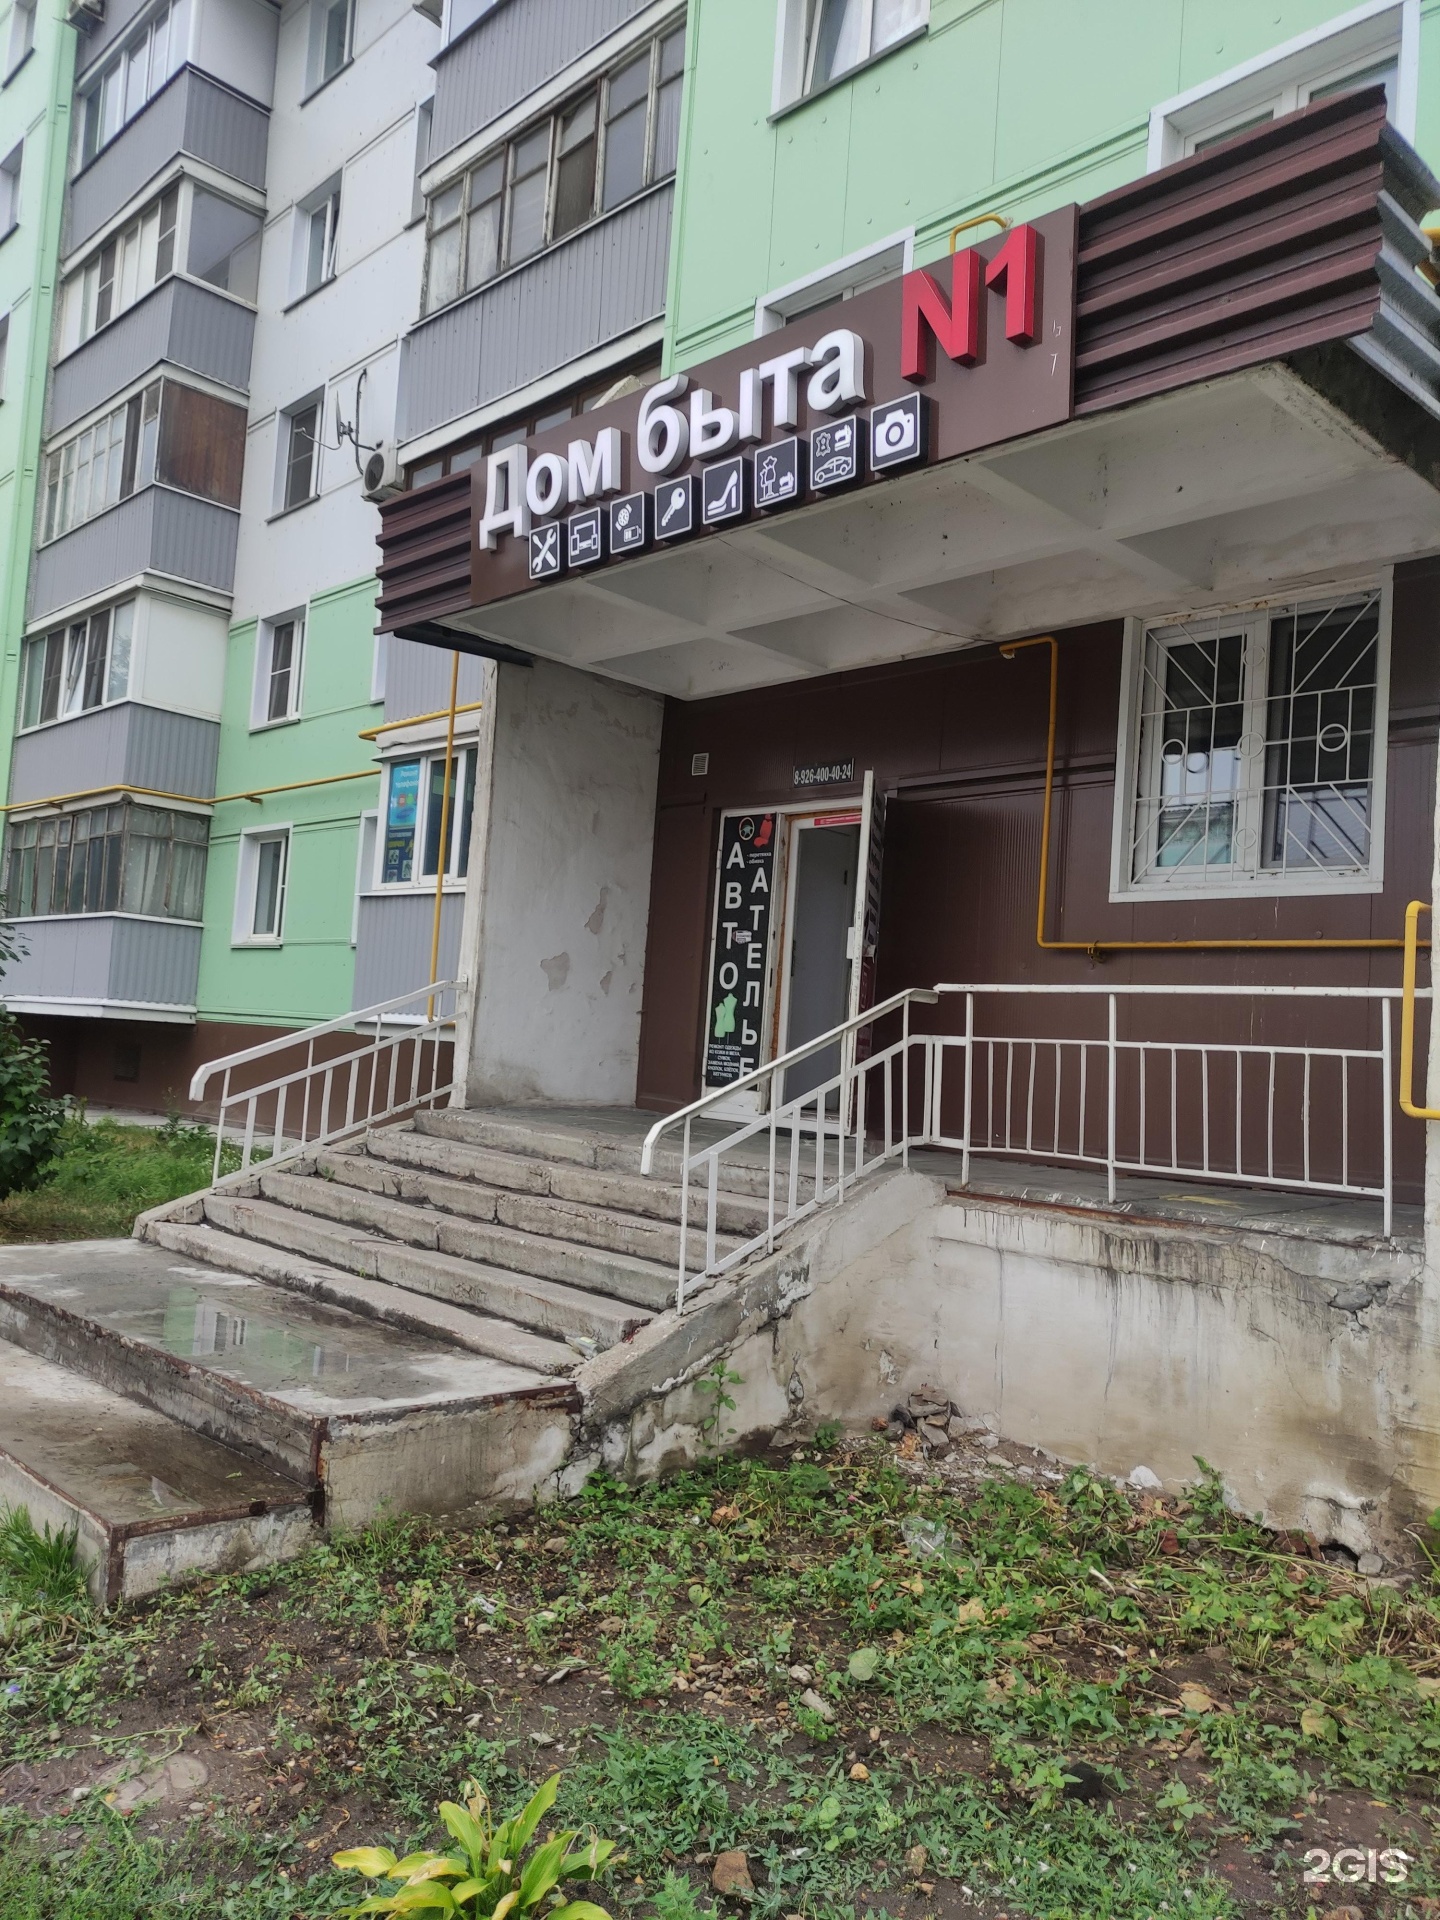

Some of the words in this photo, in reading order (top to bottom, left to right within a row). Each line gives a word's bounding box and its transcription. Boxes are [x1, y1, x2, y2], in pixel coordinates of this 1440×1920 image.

[479, 443, 621, 551] Дом
[637, 328, 866, 476] быта
[902, 223, 1036, 386] N1
[794, 763, 851, 785] 8-926-400-40-24
[719, 841, 746, 990] АВТО
